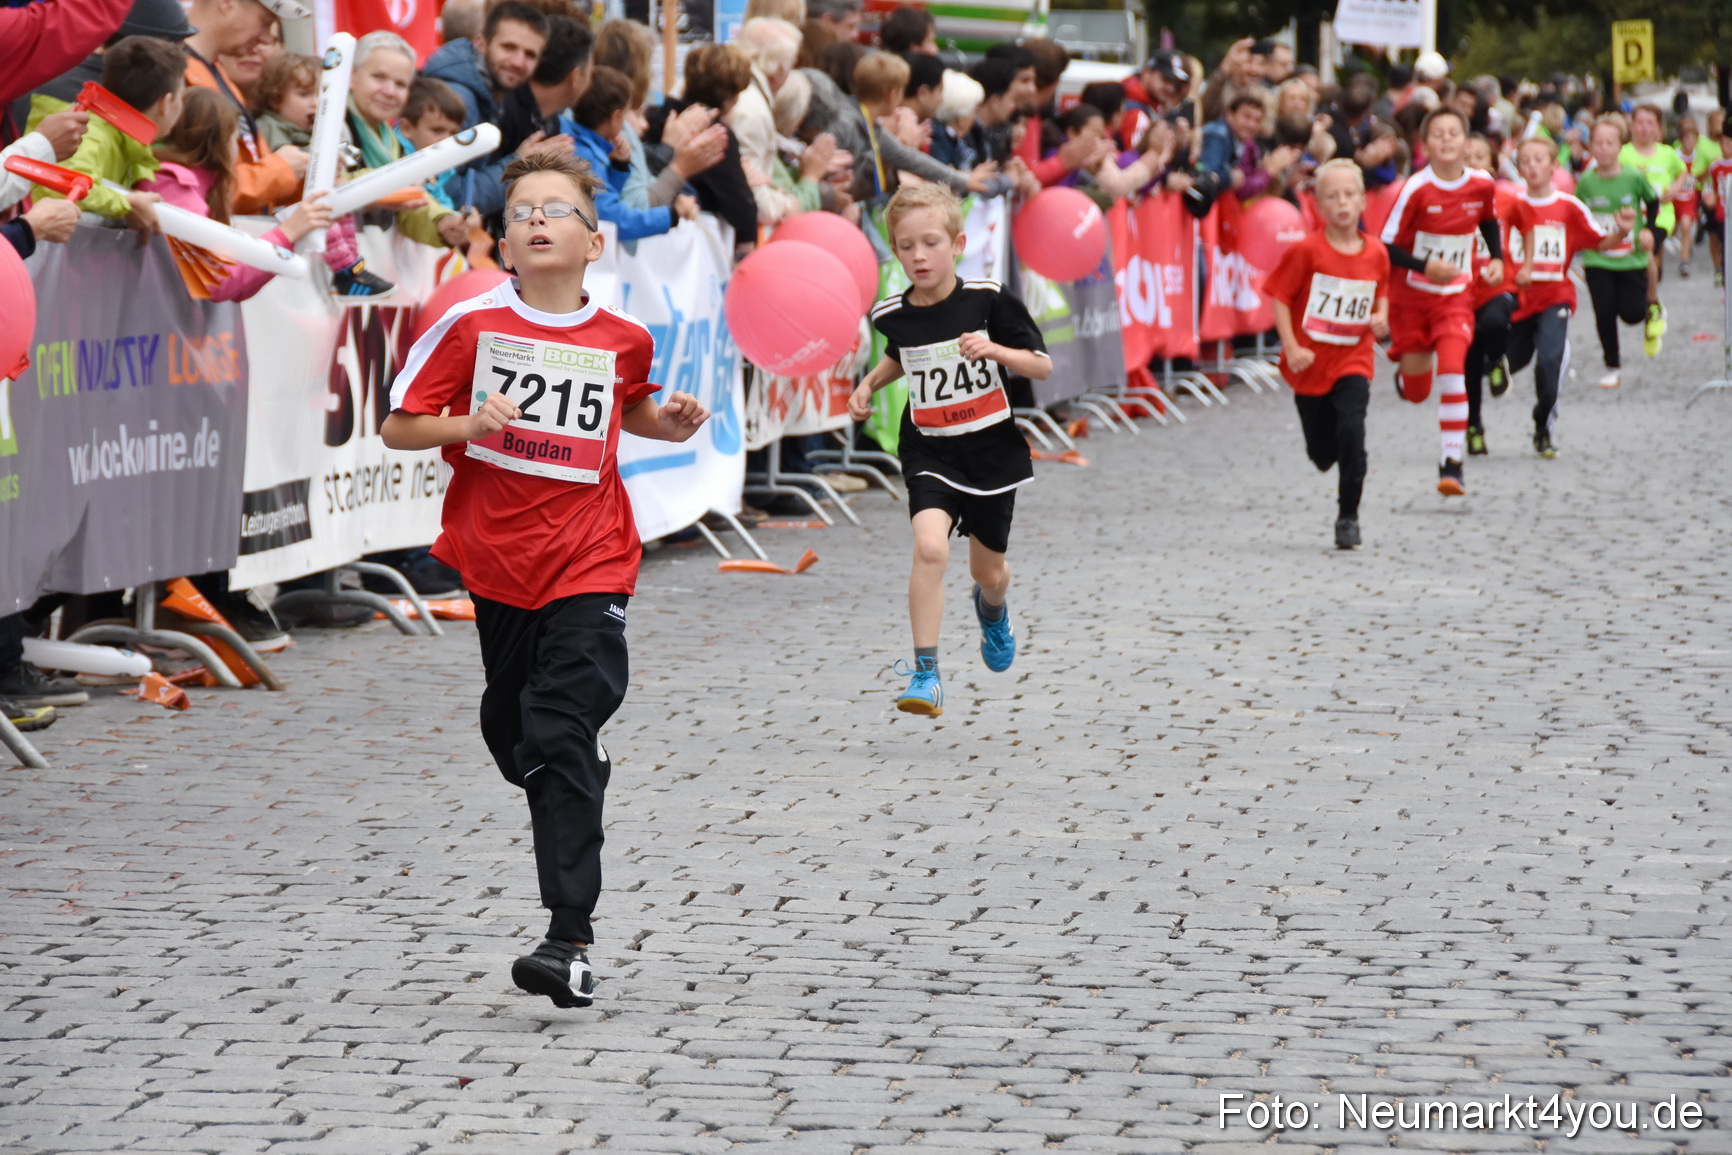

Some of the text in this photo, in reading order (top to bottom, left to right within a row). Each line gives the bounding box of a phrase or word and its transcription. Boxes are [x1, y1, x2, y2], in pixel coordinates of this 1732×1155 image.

[1624, 40, 1643, 66] D
[1318, 291, 1369, 319] 7146
[489, 347, 535, 362] NeuerMarkt
[543, 347, 609, 371] BOCK
[911, 359, 991, 403] 7243
[491, 365, 604, 432] 7215
[943, 407, 976, 424] Leon
[502, 431, 572, 462] Bogdan
[609, 603, 625, 618] JAKO
